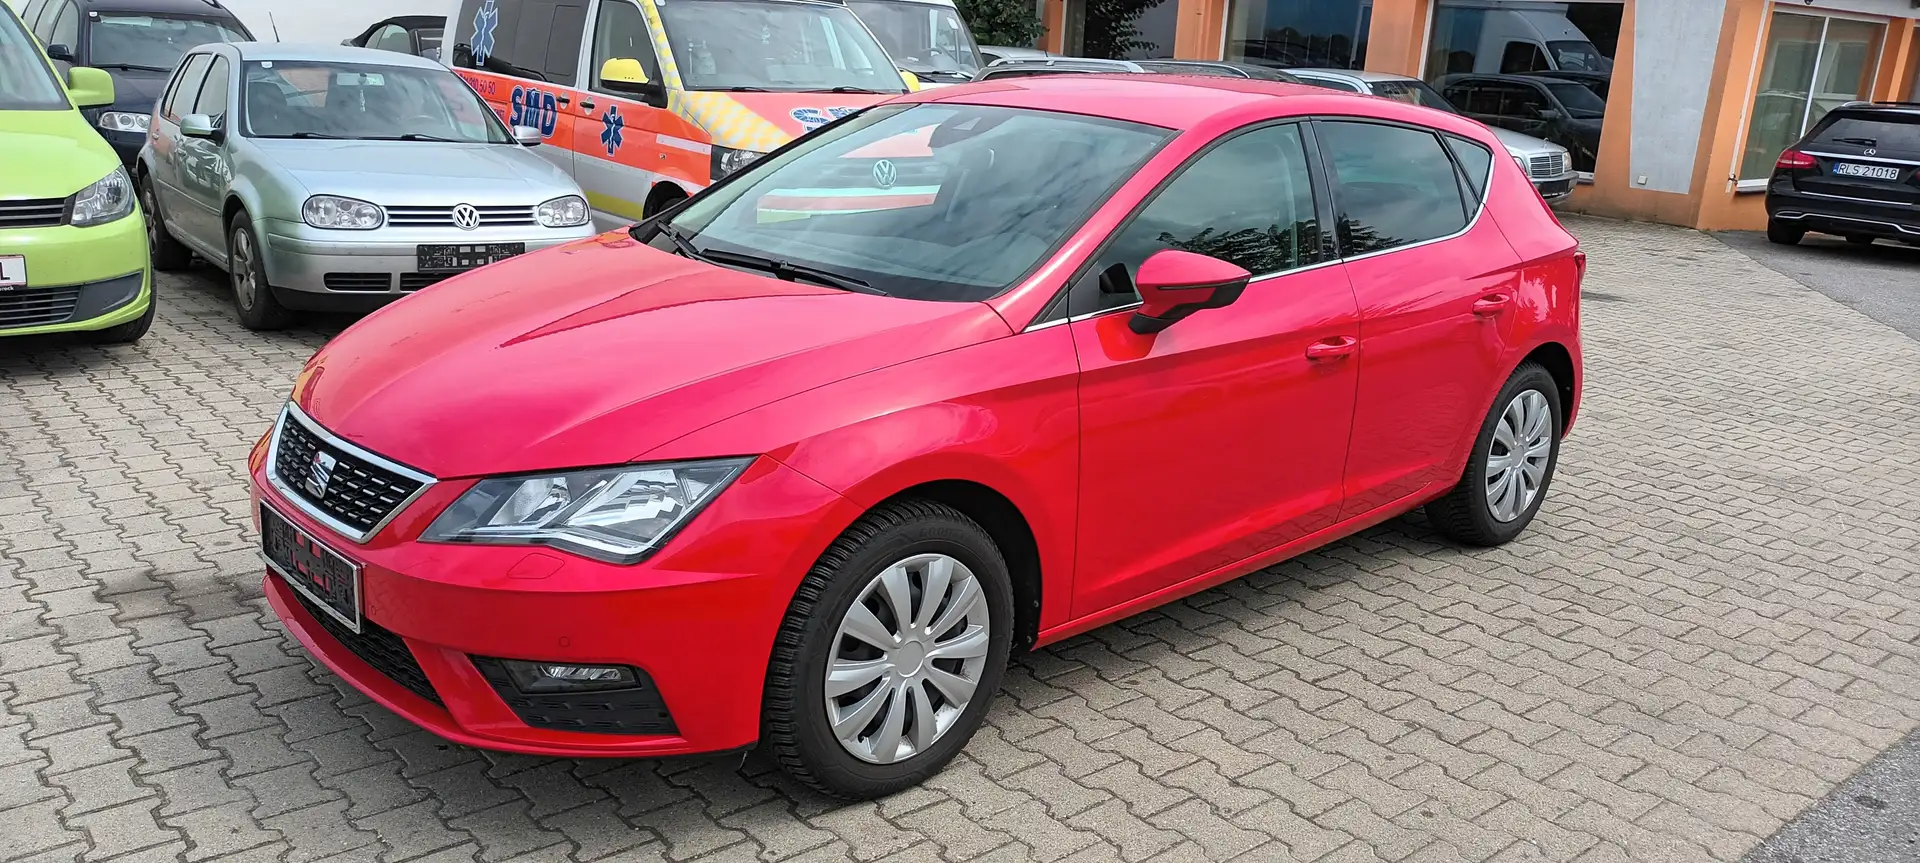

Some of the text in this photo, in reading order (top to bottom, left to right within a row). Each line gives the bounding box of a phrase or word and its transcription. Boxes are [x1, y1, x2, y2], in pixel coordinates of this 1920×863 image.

[510, 85, 558, 138] SMD
[1839, 163, 1897, 179] RLS 21018
